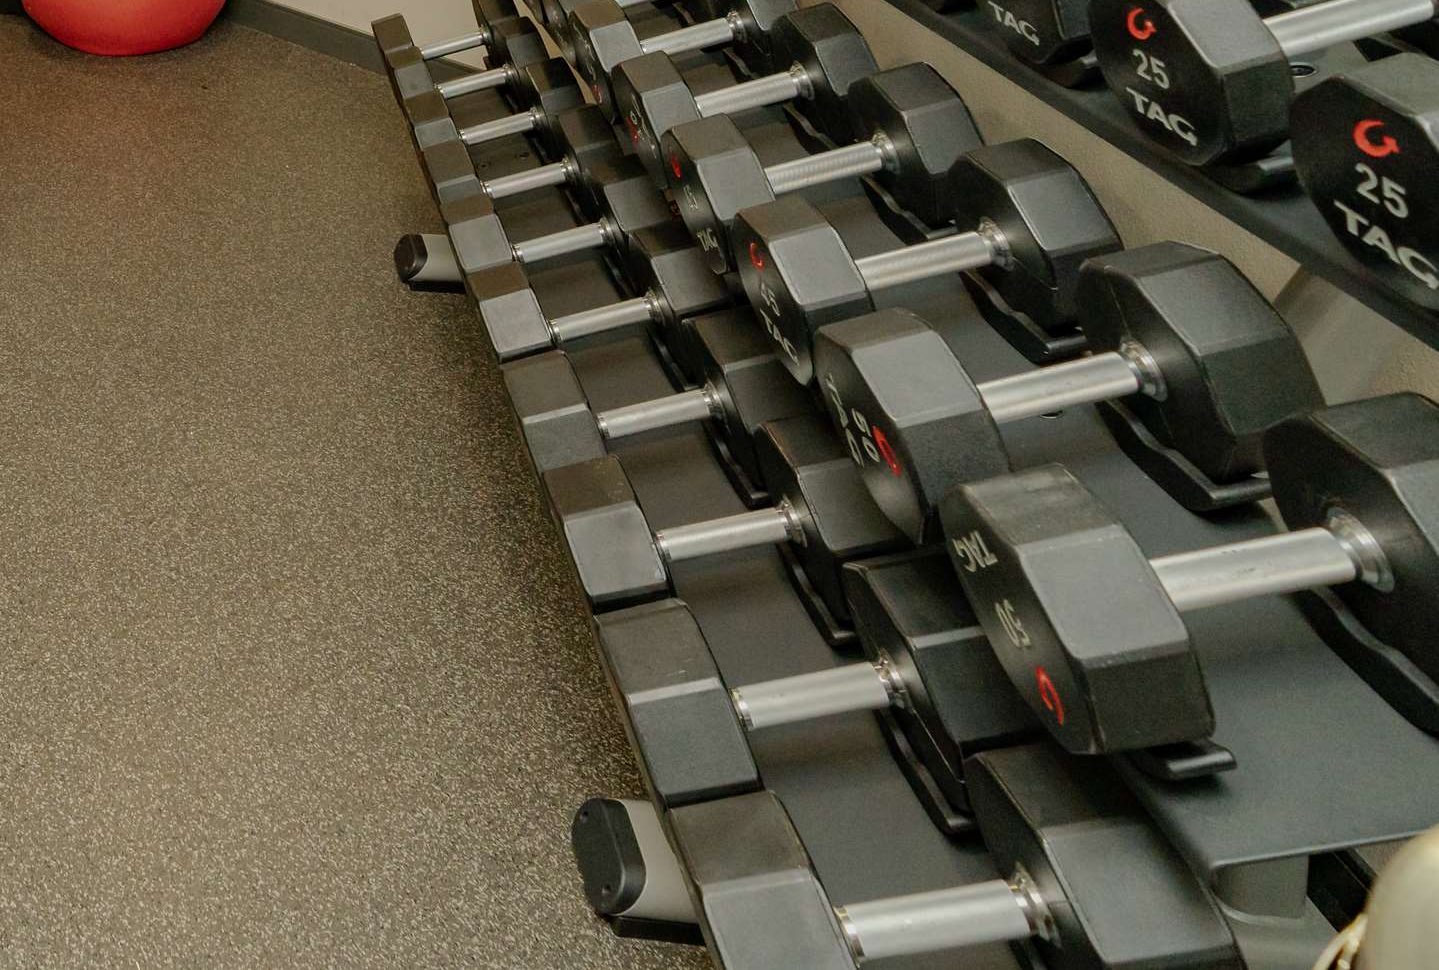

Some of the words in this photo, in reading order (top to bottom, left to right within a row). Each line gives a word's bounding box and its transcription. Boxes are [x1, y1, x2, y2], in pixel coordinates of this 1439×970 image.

[987, 0, 1040, 46] TAG
[1132, 48, 1170, 90] 25
[1126, 86, 1198, 146] TAG
[1354, 162, 1409, 218] 25
[1334, 199, 1439, 290] TAG
[952, 530, 999, 573] TAG
[994, 598, 1032, 648] 50
